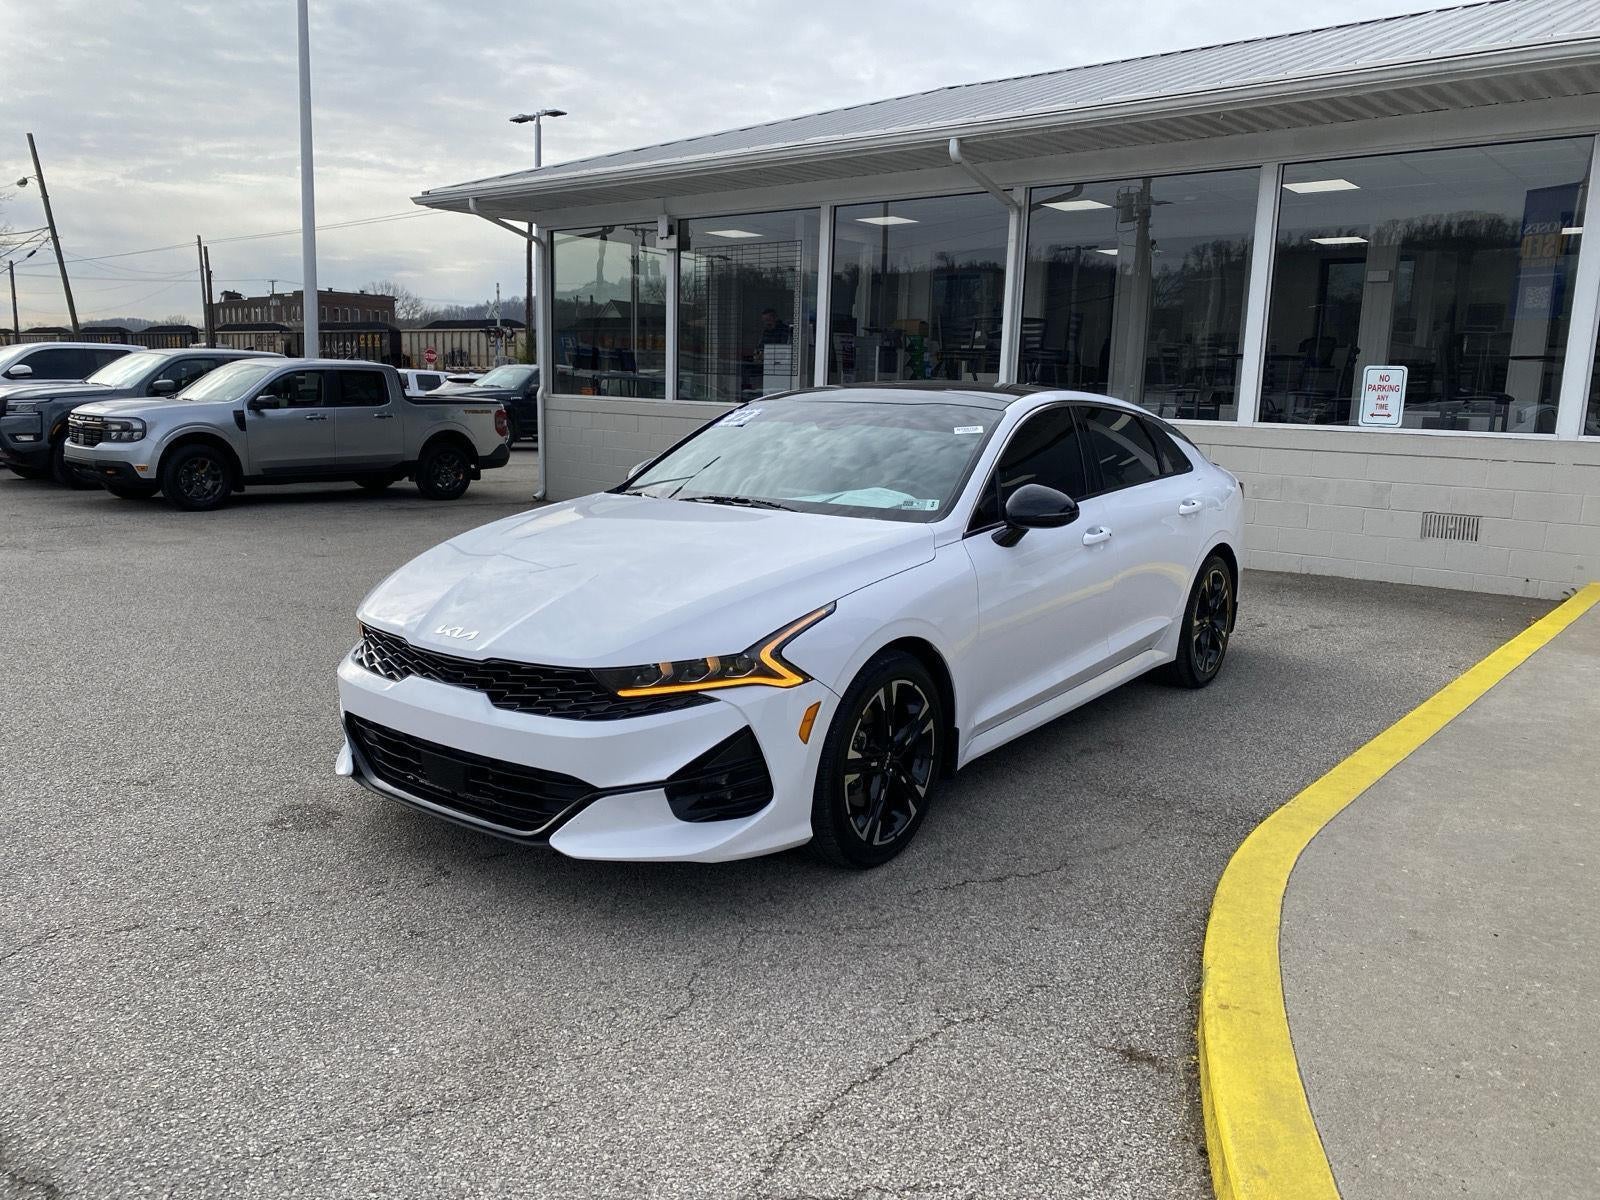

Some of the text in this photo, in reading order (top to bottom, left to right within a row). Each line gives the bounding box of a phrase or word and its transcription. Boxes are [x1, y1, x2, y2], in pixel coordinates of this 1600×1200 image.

[1379, 374, 1391, 382] NO
[1367, 384, 1400, 393] PARKING
[1375, 403, 1389, 411] TIME
[434, 624, 480, 641] KIA
